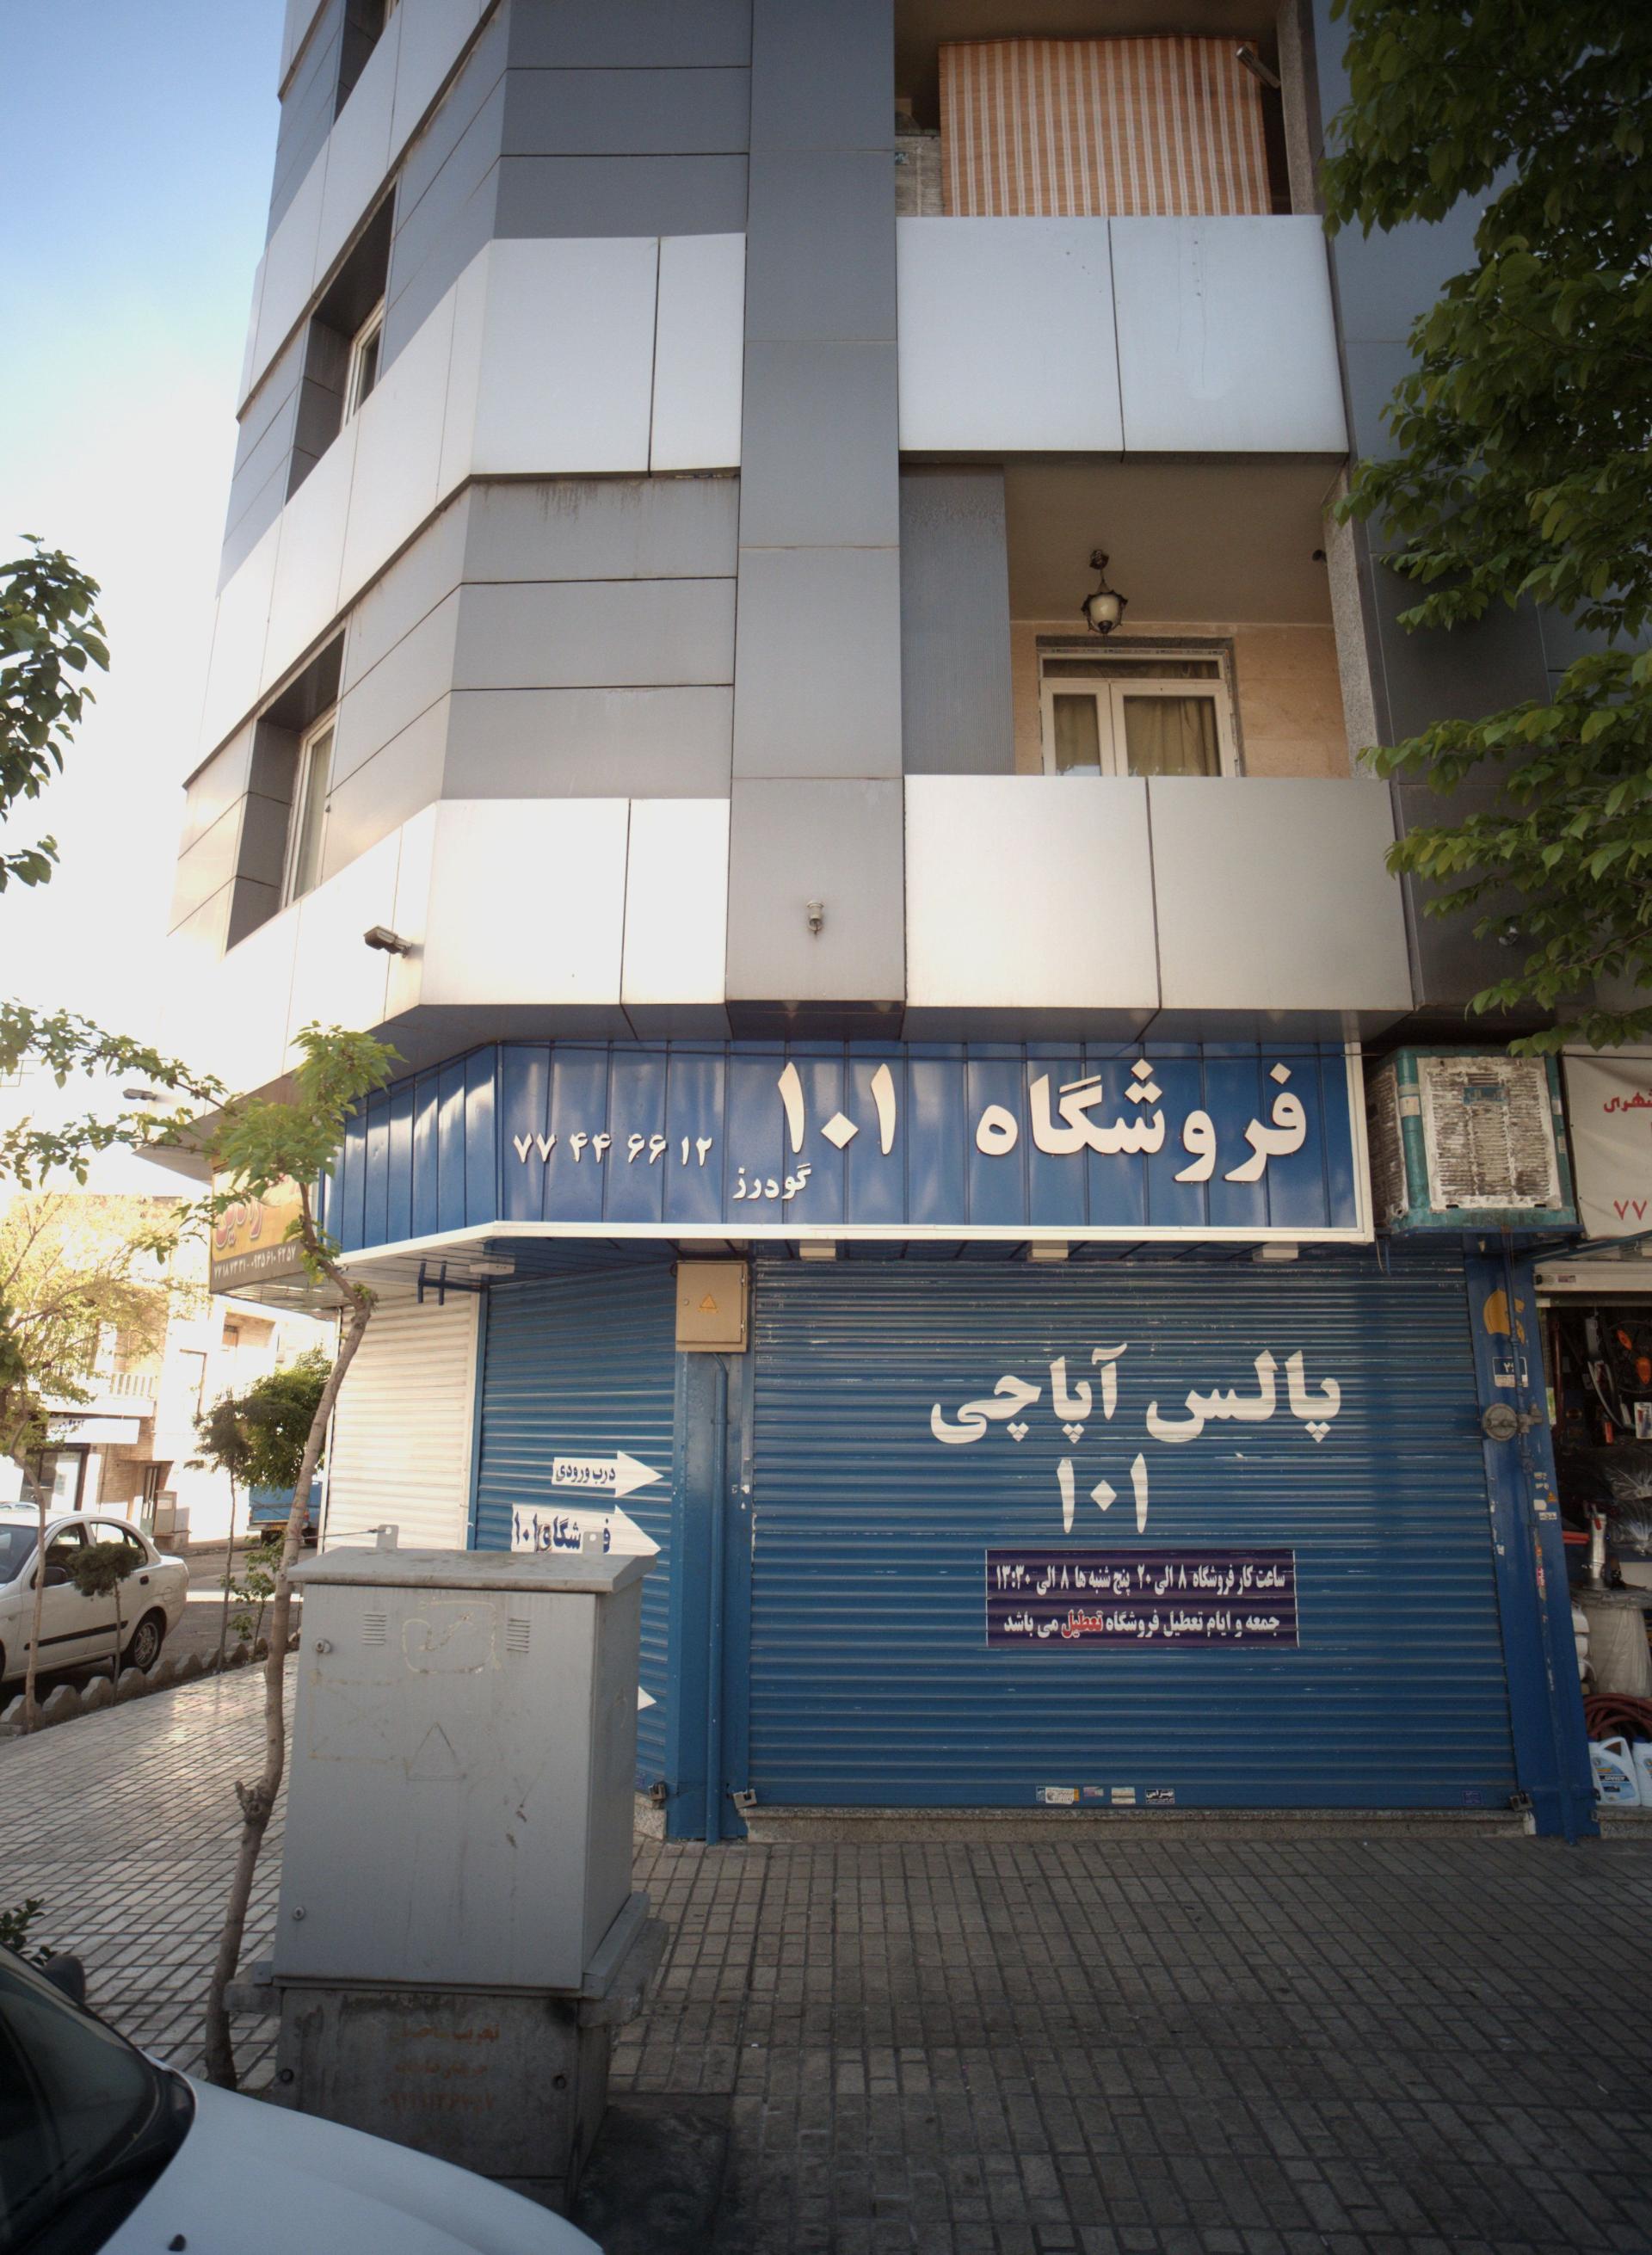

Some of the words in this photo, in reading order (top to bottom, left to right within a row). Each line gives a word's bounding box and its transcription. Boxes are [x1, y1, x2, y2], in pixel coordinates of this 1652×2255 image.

[777, 1061, 897, 1155] ۱۰۱
[976, 1058, 1307, 1182] فروشگاه
[732, 1163, 811, 1200] گودرز
[930, 1343, 1128, 1445] آپاچی
[1146, 1349, 1341, 1444] پالس
[555, 1464, 590, 1483] ورودی
[592, 1467, 616, 1484] درب
[1057, 1452, 1149, 1534] ۱۰۱
[1036, 1564, 1056, 1596] الی
[1060, 1563, 1069, 1589] ۸
[1075, 1564, 1087, 1589] ها
[1088, 1565, 1111, 1595] شنبه
[1113, 1566, 1131, 1597] پنج
[1137, 1562, 1151, 1589] ۲۰
[1154, 1564, 1174, 1596] الی
[1178, 1564, 1187, 1589] ۸
[1192, 1563, 1236, 1596] فروشگاه
[1237, 1564, 1253, 1595] کار
[1255, 1564, 1285, 1590] ساعت
[1003, 1611, 1034, 1637] باشد
[1037, 1618, 1059, 1639] می
[1060, 1608, 1105, 1639] تعطیل
[1106, 1609, 1160, 1638] فروشگاه
[1162, 1610, 1205, 1638] تعطیل
[1206, 1611, 1232, 1638] ایام
[1234, 1619, 1242, 1638] و
[1245, 1612, 1280, 1637] جمعه
